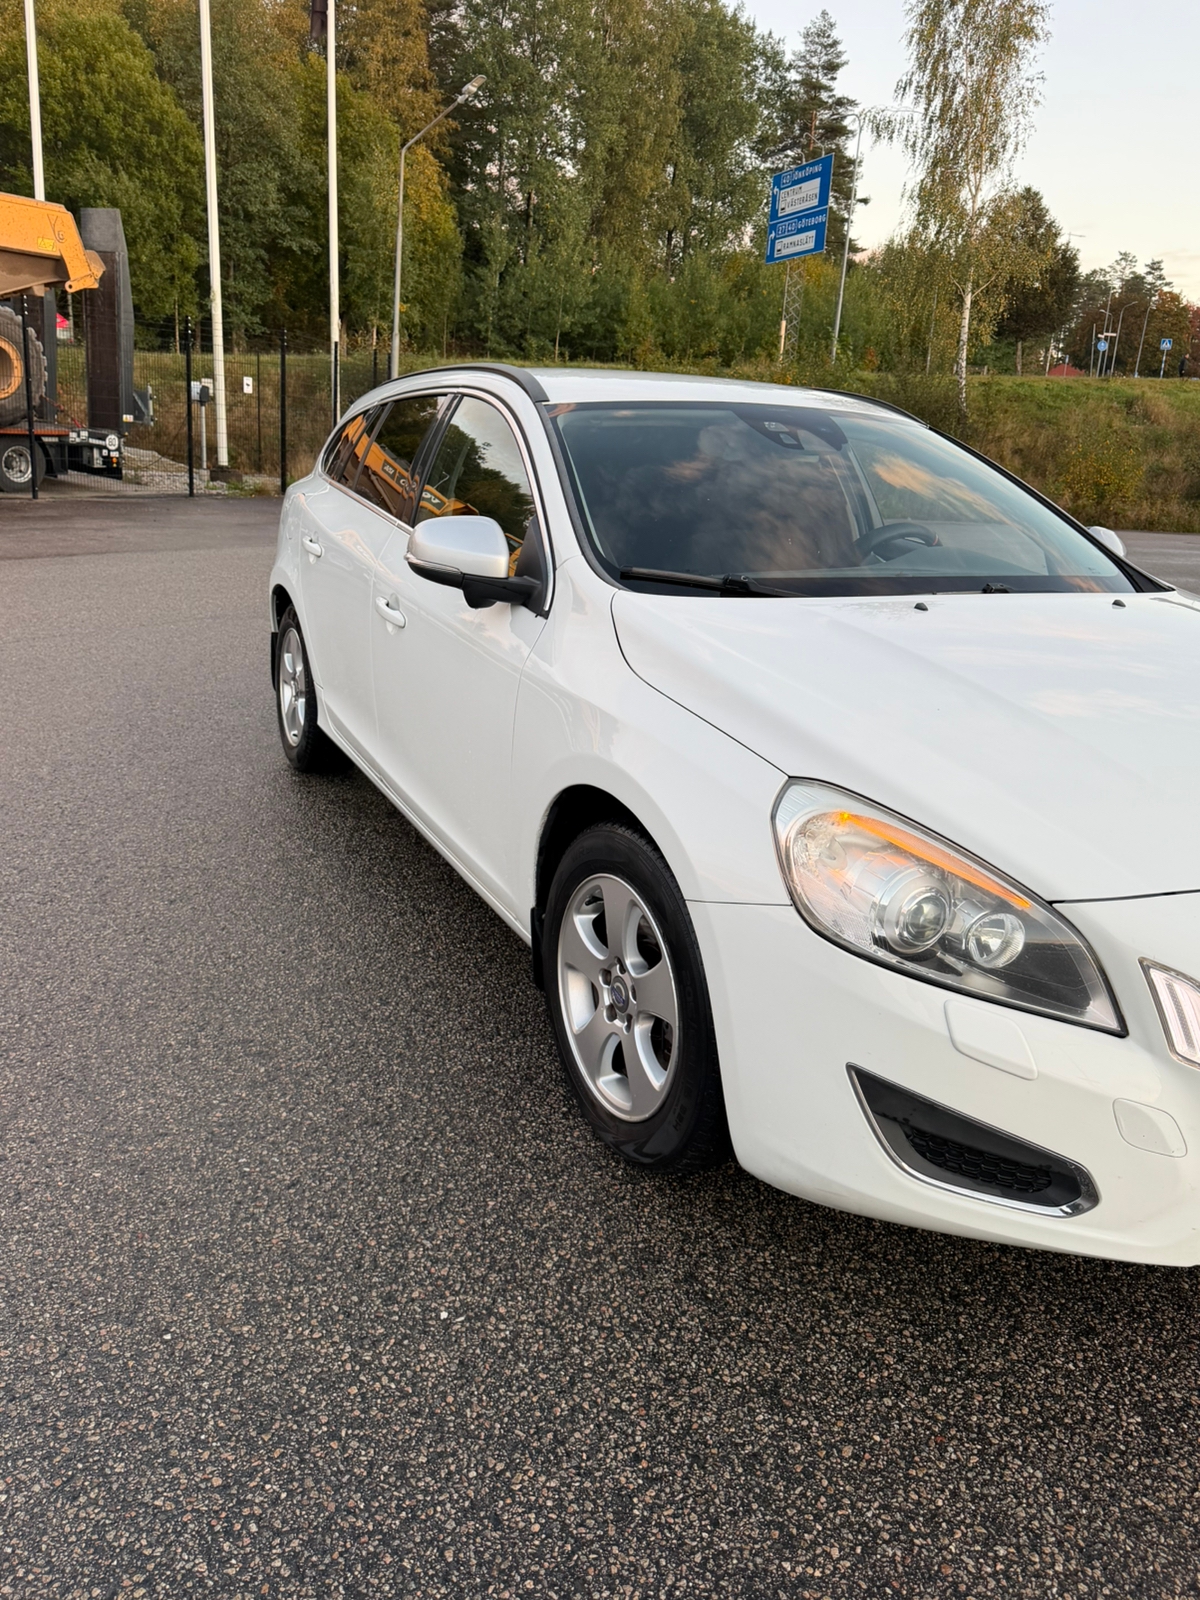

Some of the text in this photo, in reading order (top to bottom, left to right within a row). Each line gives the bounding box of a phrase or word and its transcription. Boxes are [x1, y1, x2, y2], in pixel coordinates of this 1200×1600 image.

[783, 164, 822, 184] 40 JÖNKÖPING
[781, 186, 802, 199] CENTRUM
[778, 214, 826, 235] 27 40 GÖTEBORG
